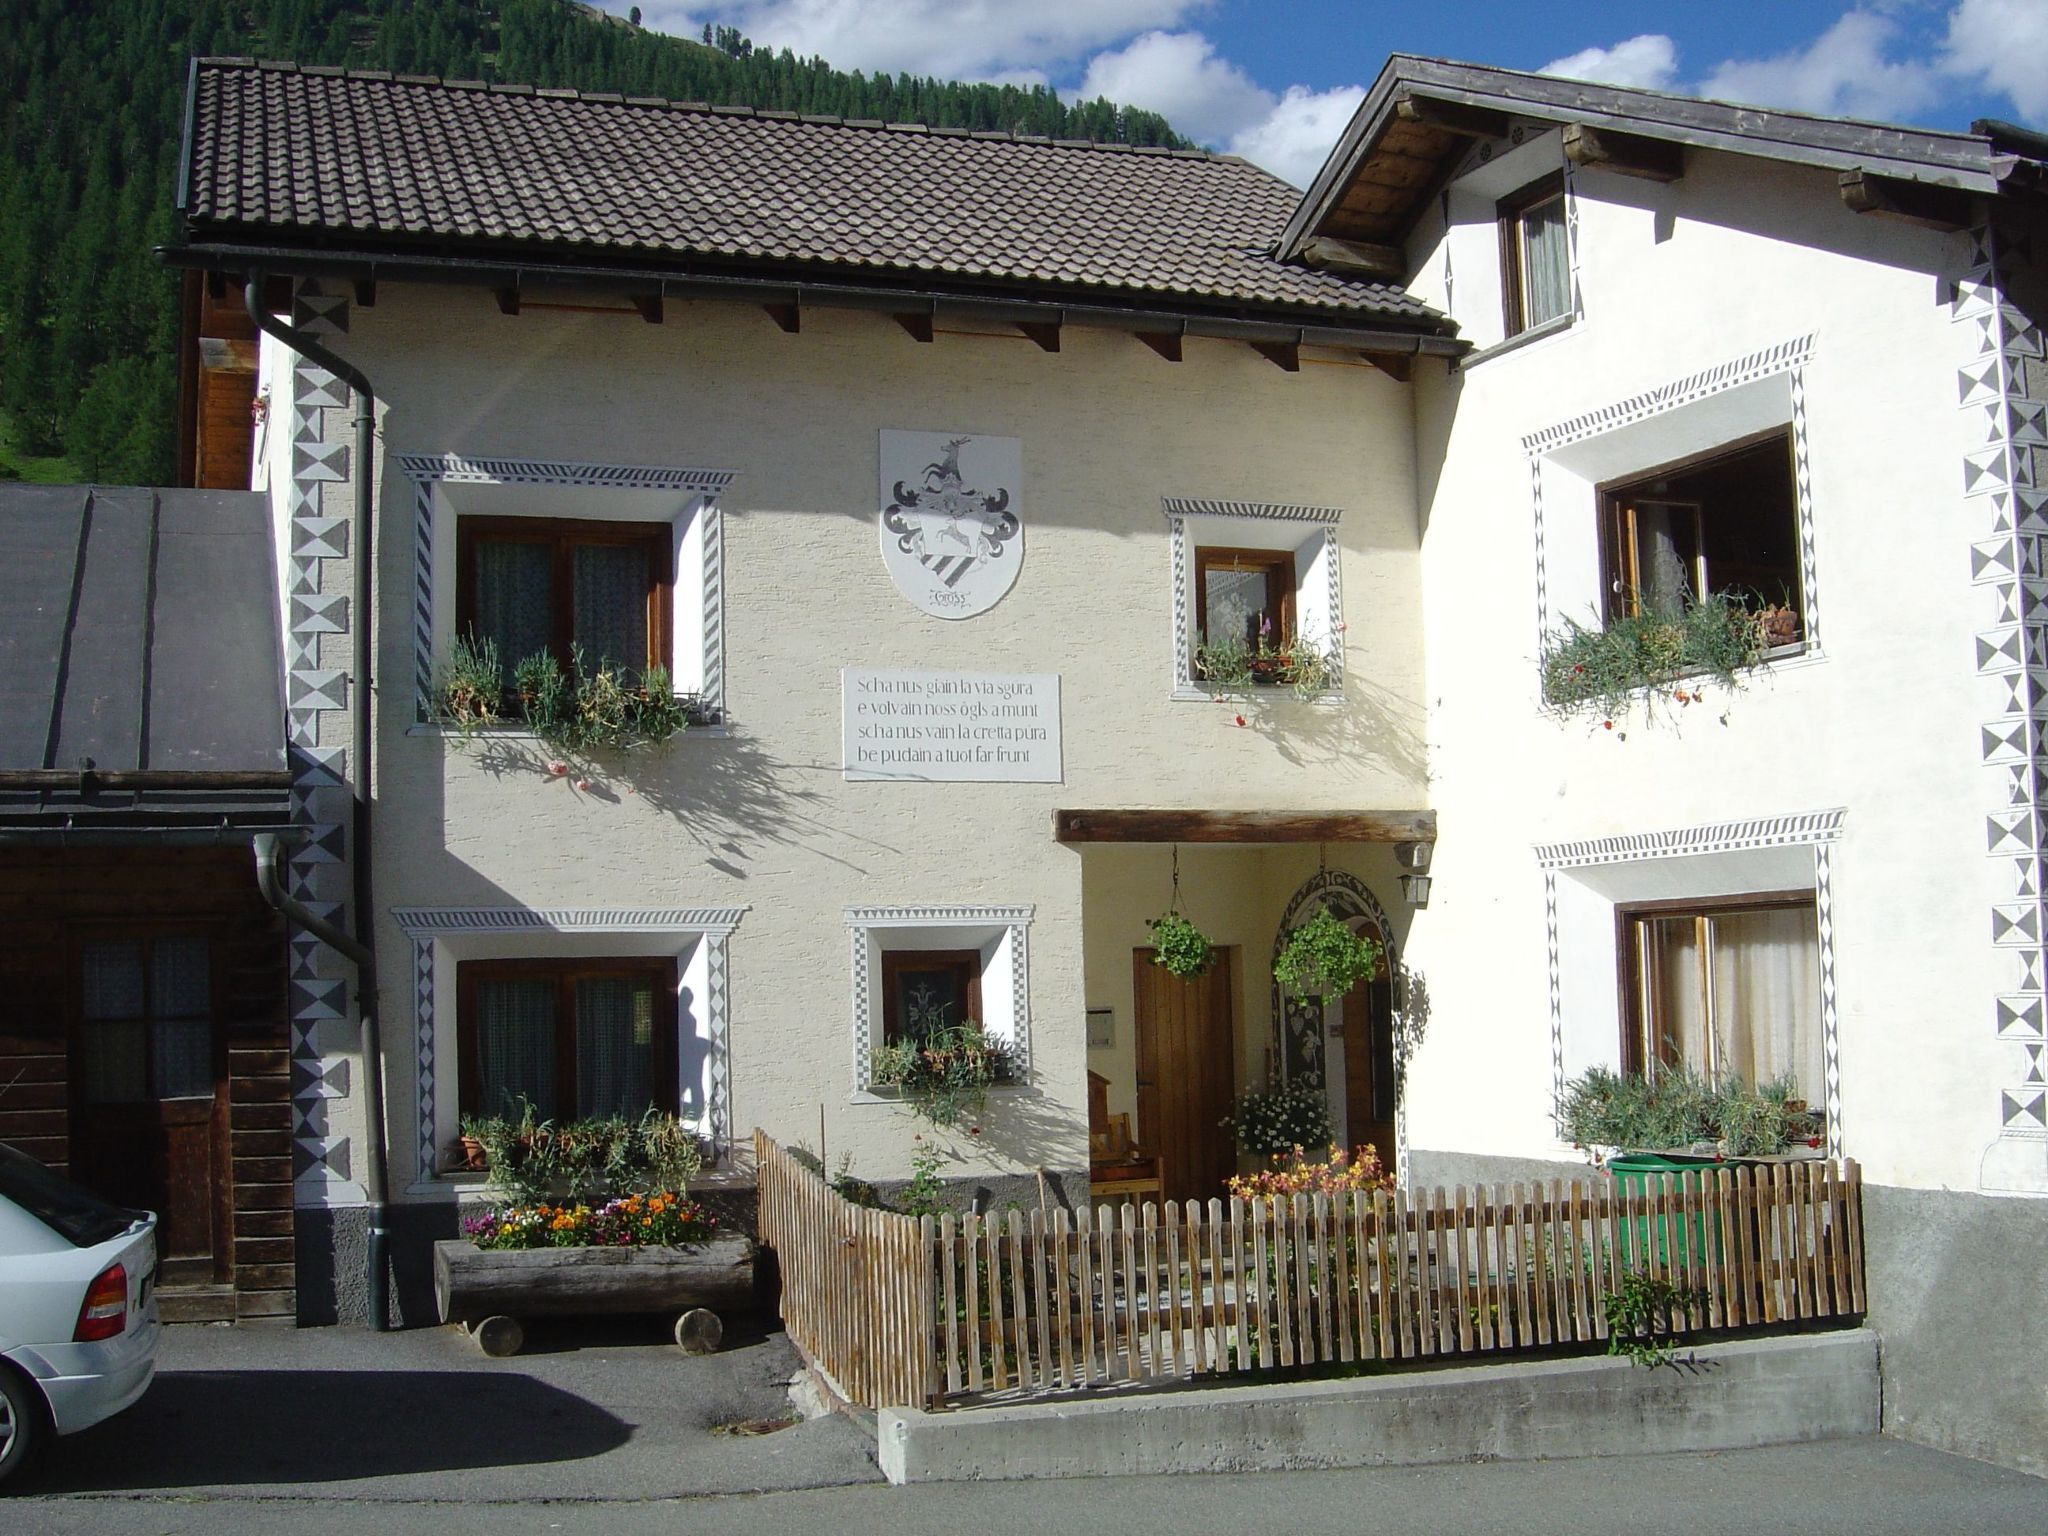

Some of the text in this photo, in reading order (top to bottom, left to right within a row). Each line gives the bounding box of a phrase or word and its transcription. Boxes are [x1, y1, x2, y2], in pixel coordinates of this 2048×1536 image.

[858, 677, 892, 693] Scha
[896, 681, 922, 693] nus
[961, 680, 972, 694] la
[975, 681, 994, 694] via
[858, 702, 867, 715] e
[871, 701, 921, 715] volvain
[925, 703, 957, 716] noss
[992, 704, 999, 717] a
[1002, 704, 1038, 717] munt
[858, 723, 893, 739] scha
[896, 727, 922, 739] nus
[926, 725, 955, 739] vain
[958, 724, 970, 739] la
[973, 726, 1012, 740] cretta
[858, 746, 1030, 765] be pudain a tuot far frunt
